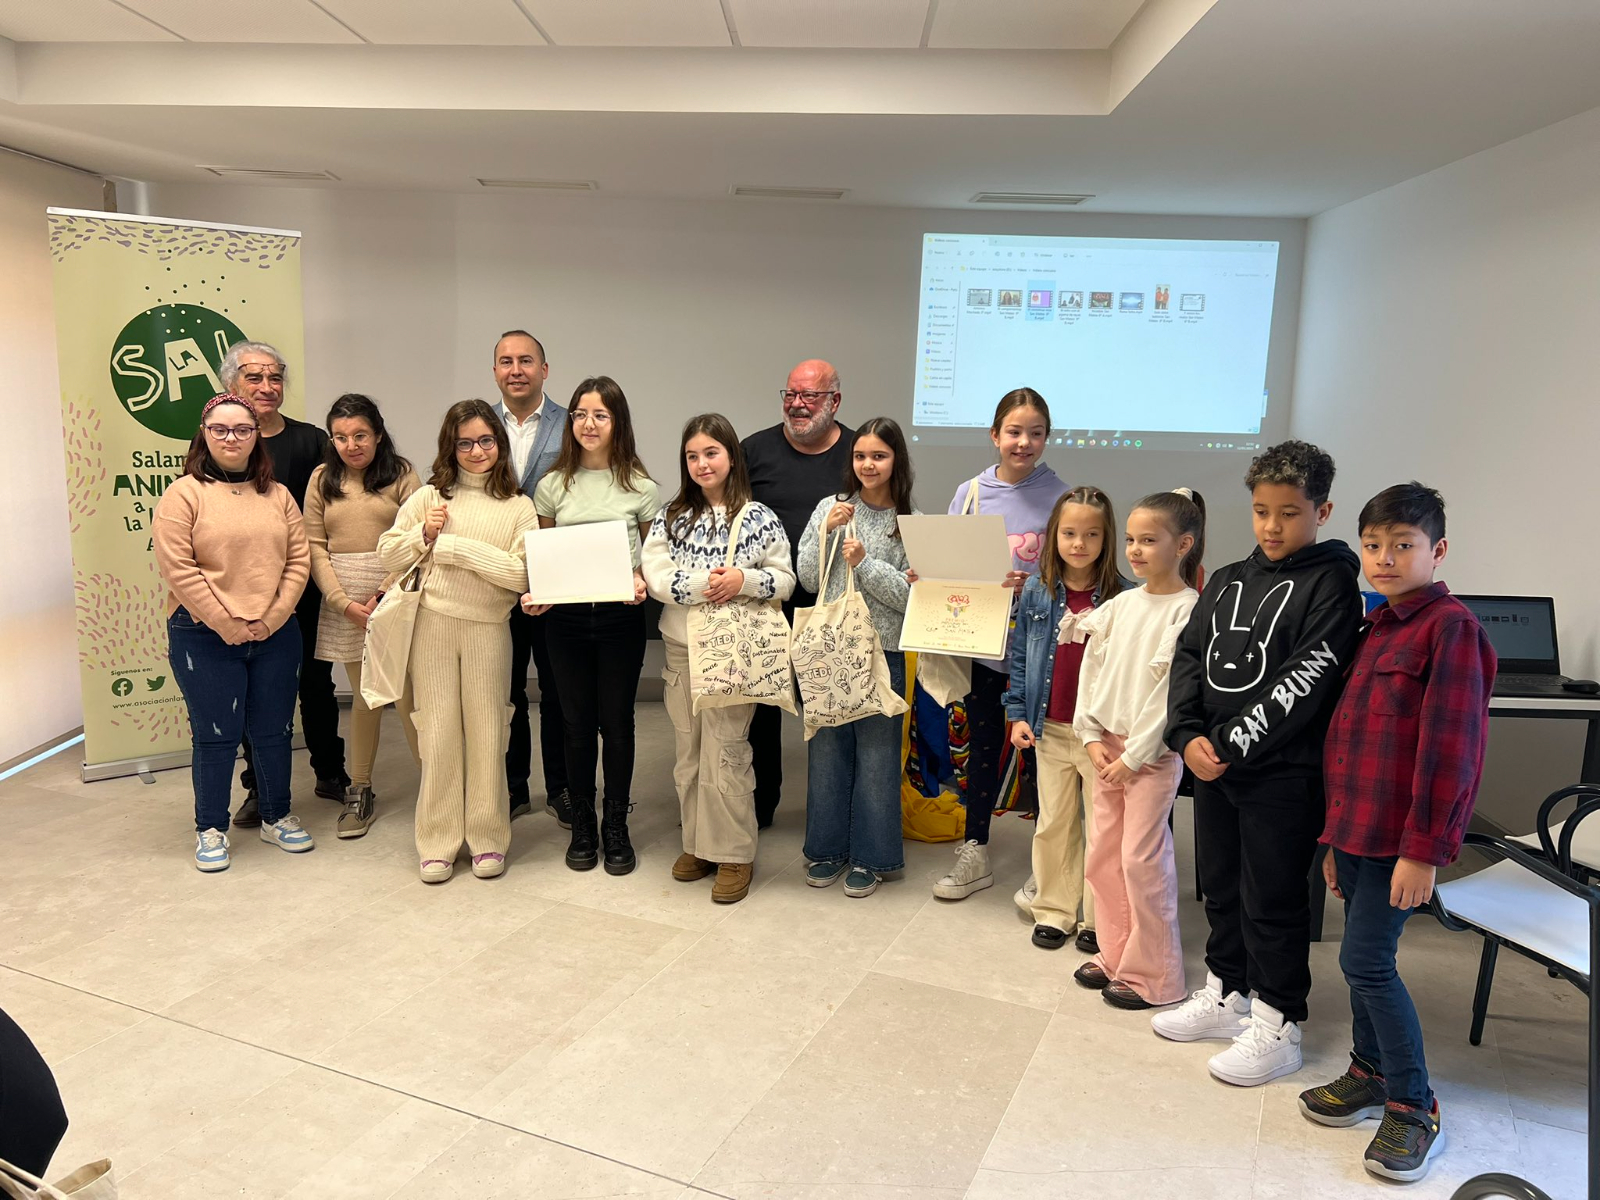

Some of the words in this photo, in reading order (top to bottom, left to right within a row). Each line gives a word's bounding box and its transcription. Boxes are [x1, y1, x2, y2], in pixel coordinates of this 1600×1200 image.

[168, 350, 198, 371] LA
[133, 501, 146, 513] a
[123, 516, 143, 532] la
[709, 632, 735, 648] TEDi
[752, 648, 786, 658] sustainable
[806, 666, 832, 680] TEDi
[747, 675, 765, 689] think
[1229, 703, 1269, 758] BAD
[1271, 641, 1339, 717] BUNNY
